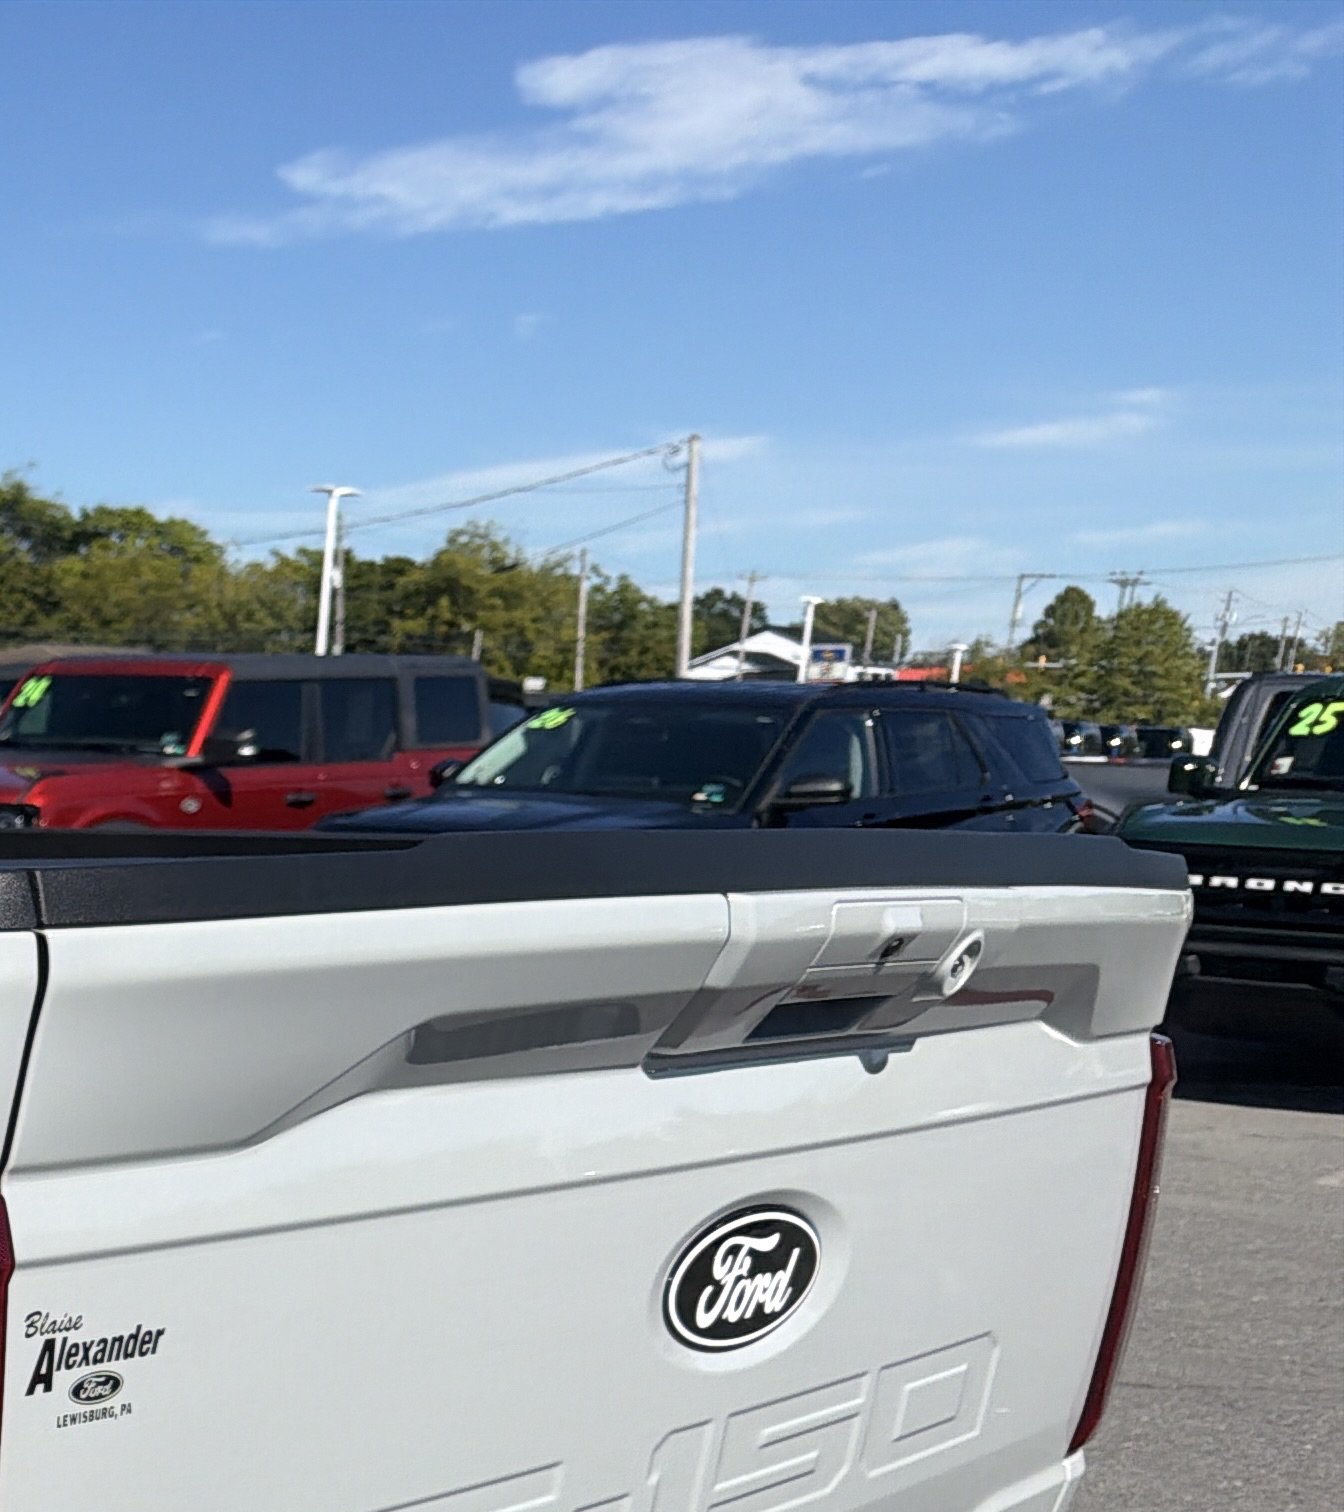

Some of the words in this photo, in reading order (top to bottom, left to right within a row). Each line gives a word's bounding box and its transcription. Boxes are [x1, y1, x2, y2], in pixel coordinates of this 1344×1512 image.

[1288, 702, 1344, 737] 25
[694, 1230, 802, 1330] Ford
[23, 1309, 84, 1340] Blaise
[23, 1323, 167, 1397] Alexander
[55, 1404, 118, 1429] LEWISBURG,
[119, 1401, 133, 1418] PA
